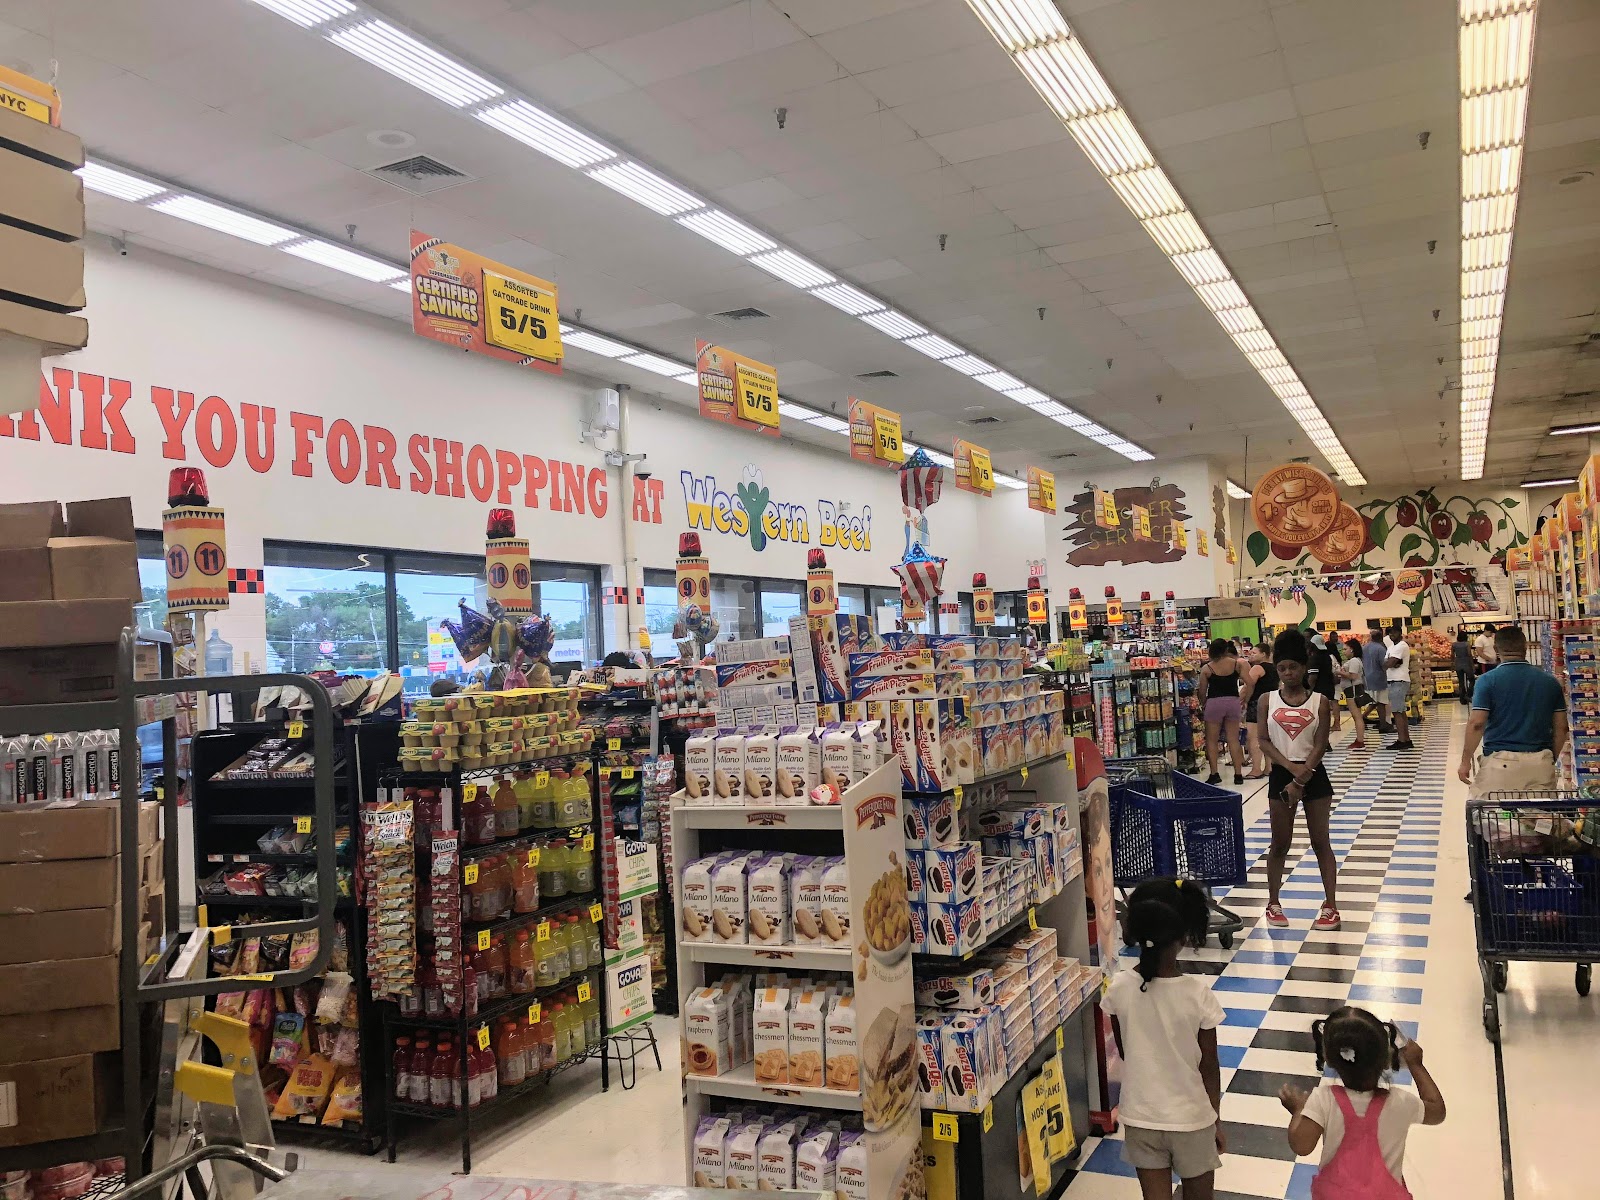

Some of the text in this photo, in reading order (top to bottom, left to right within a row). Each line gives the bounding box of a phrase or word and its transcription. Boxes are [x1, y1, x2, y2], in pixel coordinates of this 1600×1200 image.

[415, 275, 478, 304] CERTIFIED
[503, 280, 539, 299] ASSORTED
[420, 293, 478, 322] SAVINGS
[492, 289, 551, 315] GATORADE DRINK
[500, 306, 547, 340] 5/5
[700, 373, 733, 389] CERTIFIED
[703, 386, 734, 402] SAVINGS
[746, 390, 772, 412] 5/5
[0, 367, 664, 525] NK YOU FOR SHOPPING AT
[880, 433, 898, 451] 5/5
[818, 499, 872, 551] Beef
[1088, 524, 1173, 550] SERVCE
[169, 551, 184, 573] 11
[200, 547, 219, 571] 11
[489, 566, 506, 585] 10
[515, 567, 528, 585] 10
[1030, 565, 1044, 575] EXIT
[683, 580, 692, 597] 9
[701, 580, 708, 596] 9
[813, 589, 821, 602] 8
[555, 648, 581, 658] metro
[868, 655, 904, 671] Fruit Pies
[734, 666, 766, 680] Fruit Pies
[871, 680, 907, 695] Fruit Pies
[823, 753, 848, 763] Milano
[896, 731, 911, 770] Fruit Pies
[921, 731, 936, 770] Fruit Pies
[111, 751, 119, 781] essentia
[686, 756, 709, 764] Milano
[716, 756, 740, 764] Milano
[745, 756, 771, 764] Milano
[778, 754, 804, 764] Milano
[36, 758, 45, 791] essentia
[65, 757, 73, 791] essentia
[89, 753, 97, 785] essentia
[859, 797, 895, 818] PEPPERIDGE FARM
[626, 842, 647, 855] GOYA
[684, 893, 708, 901] Milano
[713, 895, 739, 903] Milano
[751, 894, 778, 903] Milano
[799, 893, 821, 902] Milan
[822, 894, 849, 903] Milano
[619, 967, 640, 986] GOYA
[687, 1026, 714, 1036] raspberry
[754, 1033, 785, 1041] chessmen
[789, 1033, 820, 1043] chessmen
[826, 1037, 857, 1046] chessmen
[940, 1123, 952, 1136] 2/5
[696, 1156, 722, 1167] Milano
[728, 1161, 754, 1172] Milano
[759, 1163, 787, 1175] Milano
[797, 1171, 818, 1184] Milano
[838, 1175, 866, 1188] Milano
